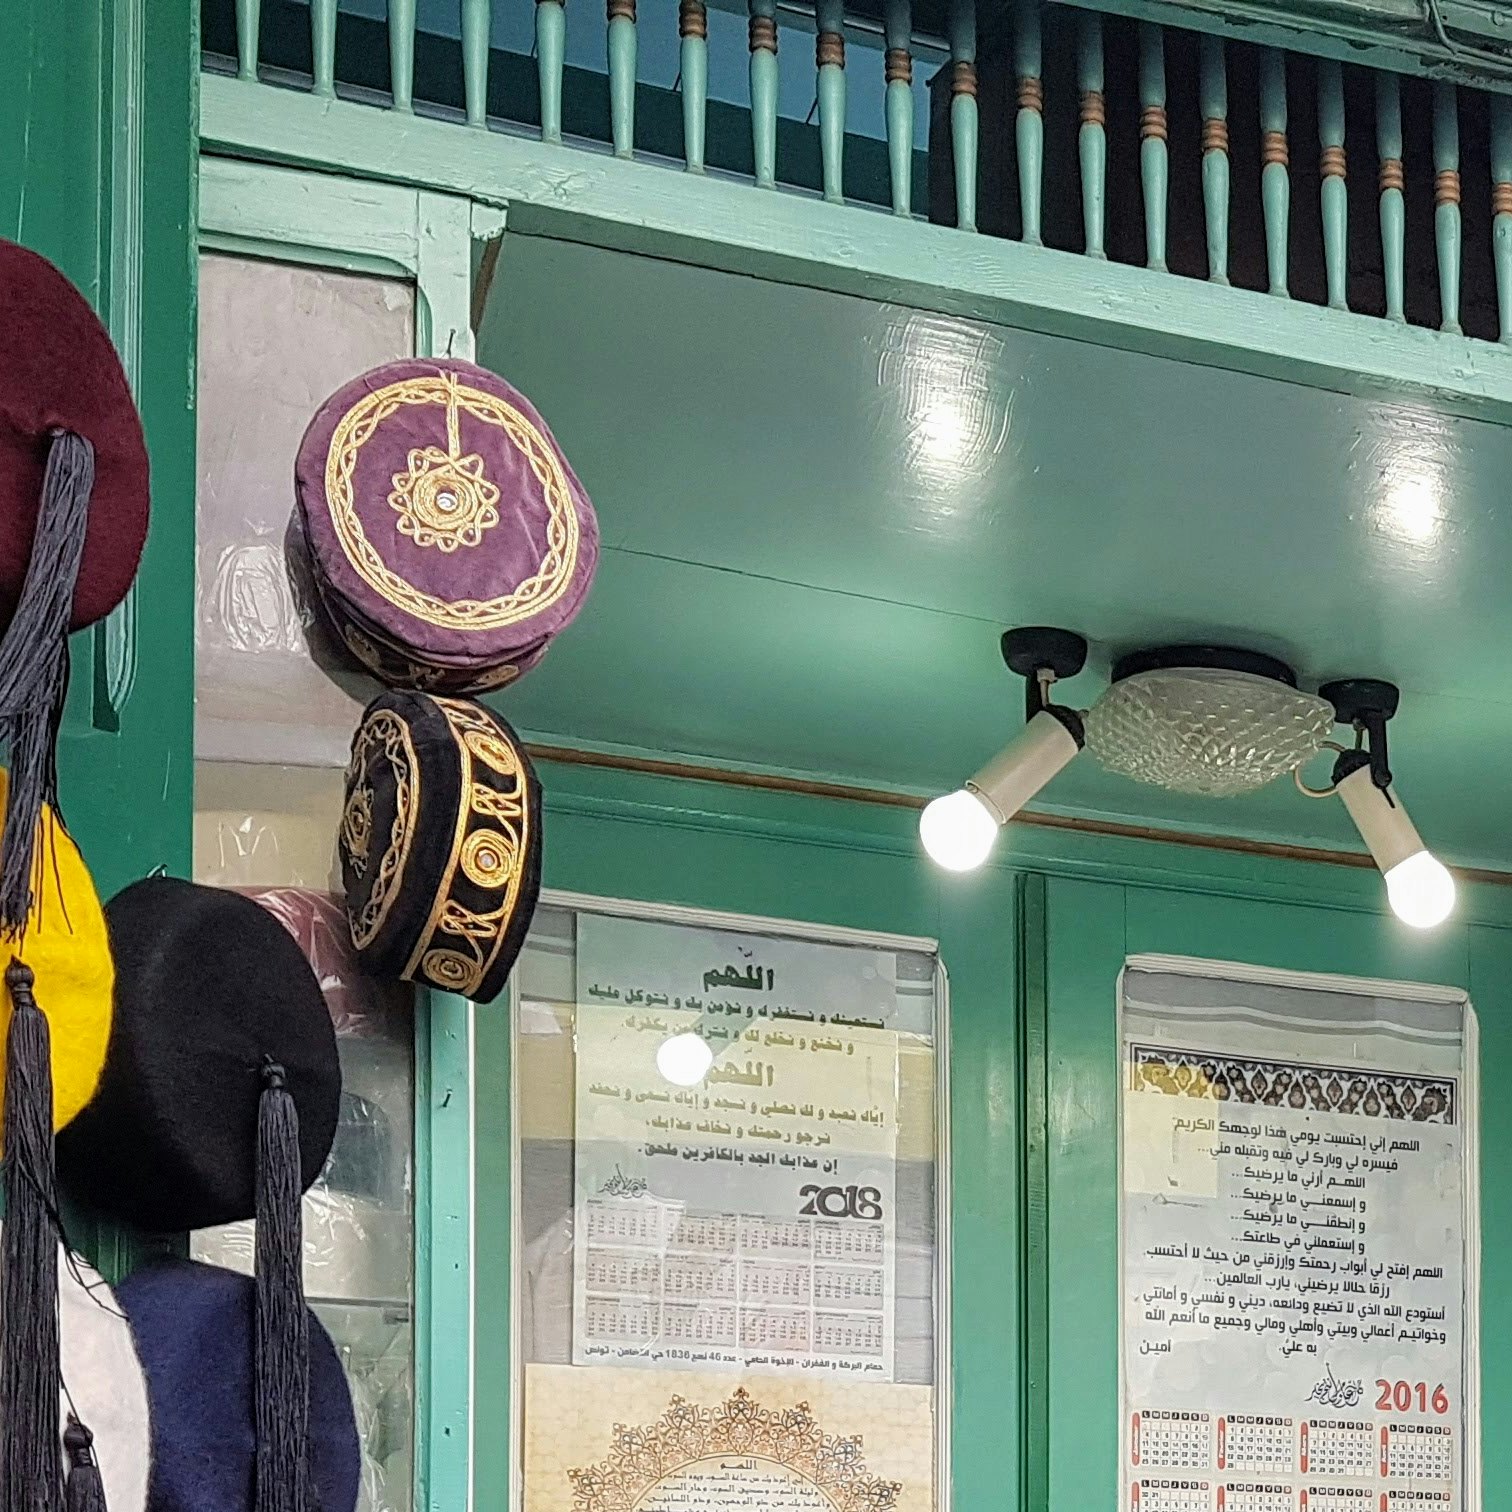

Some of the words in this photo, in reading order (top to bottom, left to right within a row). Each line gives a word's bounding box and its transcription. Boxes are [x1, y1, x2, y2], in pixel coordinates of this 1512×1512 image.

[683, 996, 702, 1013] بك
[745, 1006, 753, 1018] و
[819, 1014, 827, 1026] و
[702, 1095, 711, 1111] و
[748, 1102, 757, 1115] و
[799, 1104, 813, 1117] لك
[736, 1126, 744, 1139] و
[1218, 1122, 1261, 1139] لوجهك
[1265, 1126, 1289, 1138] هذا
[1290, 1132, 1320, 1145] يومي
[1324, 1133, 1366, 1150] إحتسبت
[1388, 1140, 1419, 1152] اللهم
[1235, 1145, 1269, 1162] وتقبله
[1272, 1148, 1292, 1166] فيه
[1295, 1149, 1310, 1167] لي
[1312, 1152, 1343, 1168] وبارك
[1345, 1155, 1359, 1169] لي
[1362, 1157, 1398, 1170] فيسره
[1286, 1169, 1298, 1182] ما
[1301, 1171, 1323, 1187] أرني
[799, 1184, 883, 1220] 2018
[1286, 1192, 1297, 1203] ما
[1287, 1213, 1297, 1224] ما
[1284, 1237, 1301, 1251] في
[1304, 1237, 1355, 1255] إستعملني
[1192, 1247, 1200, 1258] لا
[1203, 1247, 1229, 1264] حيث
[1233, 1251, 1250, 1266] من
[1298, 1256, 1336, 1273] رحمتك
[1339, 1257, 1367, 1275] أبواب
[1370, 1263, 1383, 1276] لي
[1387, 1263, 1409, 1278] إفتح
[1413, 1267, 1443, 1278] اللهم
[1342, 1281, 1366, 1297] حلالا
[1190, 1289, 1225, 1306] نفسي
[1238, 1291, 1267, 1311] ديني
[1313, 1297, 1343, 1315] تضيع
[1344, 1298, 1354, 1313] لا
[1357, 1303, 1380, 1318] الذي
[1384, 1305, 1402, 1317] الله
[1145, 1309, 1165, 1321] الله
[1169, 1311, 1195, 1326] أنعم
[1199, 1312, 1209, 1324] ما
[1405, 1306, 1445, 1321] أستودع
[1214, 1314, 1251, 1331] وجميع
[1255, 1316, 1285, 1333] ومالي
[1289, 1319, 1323, 1336] وأهلي
[1327, 1322, 1357, 1338] وبيتي
[1360, 1325, 1394, 1339] أعمالي
[1306, 1338, 1317, 1356] به
[1375, 1379, 1449, 1414] 2016
